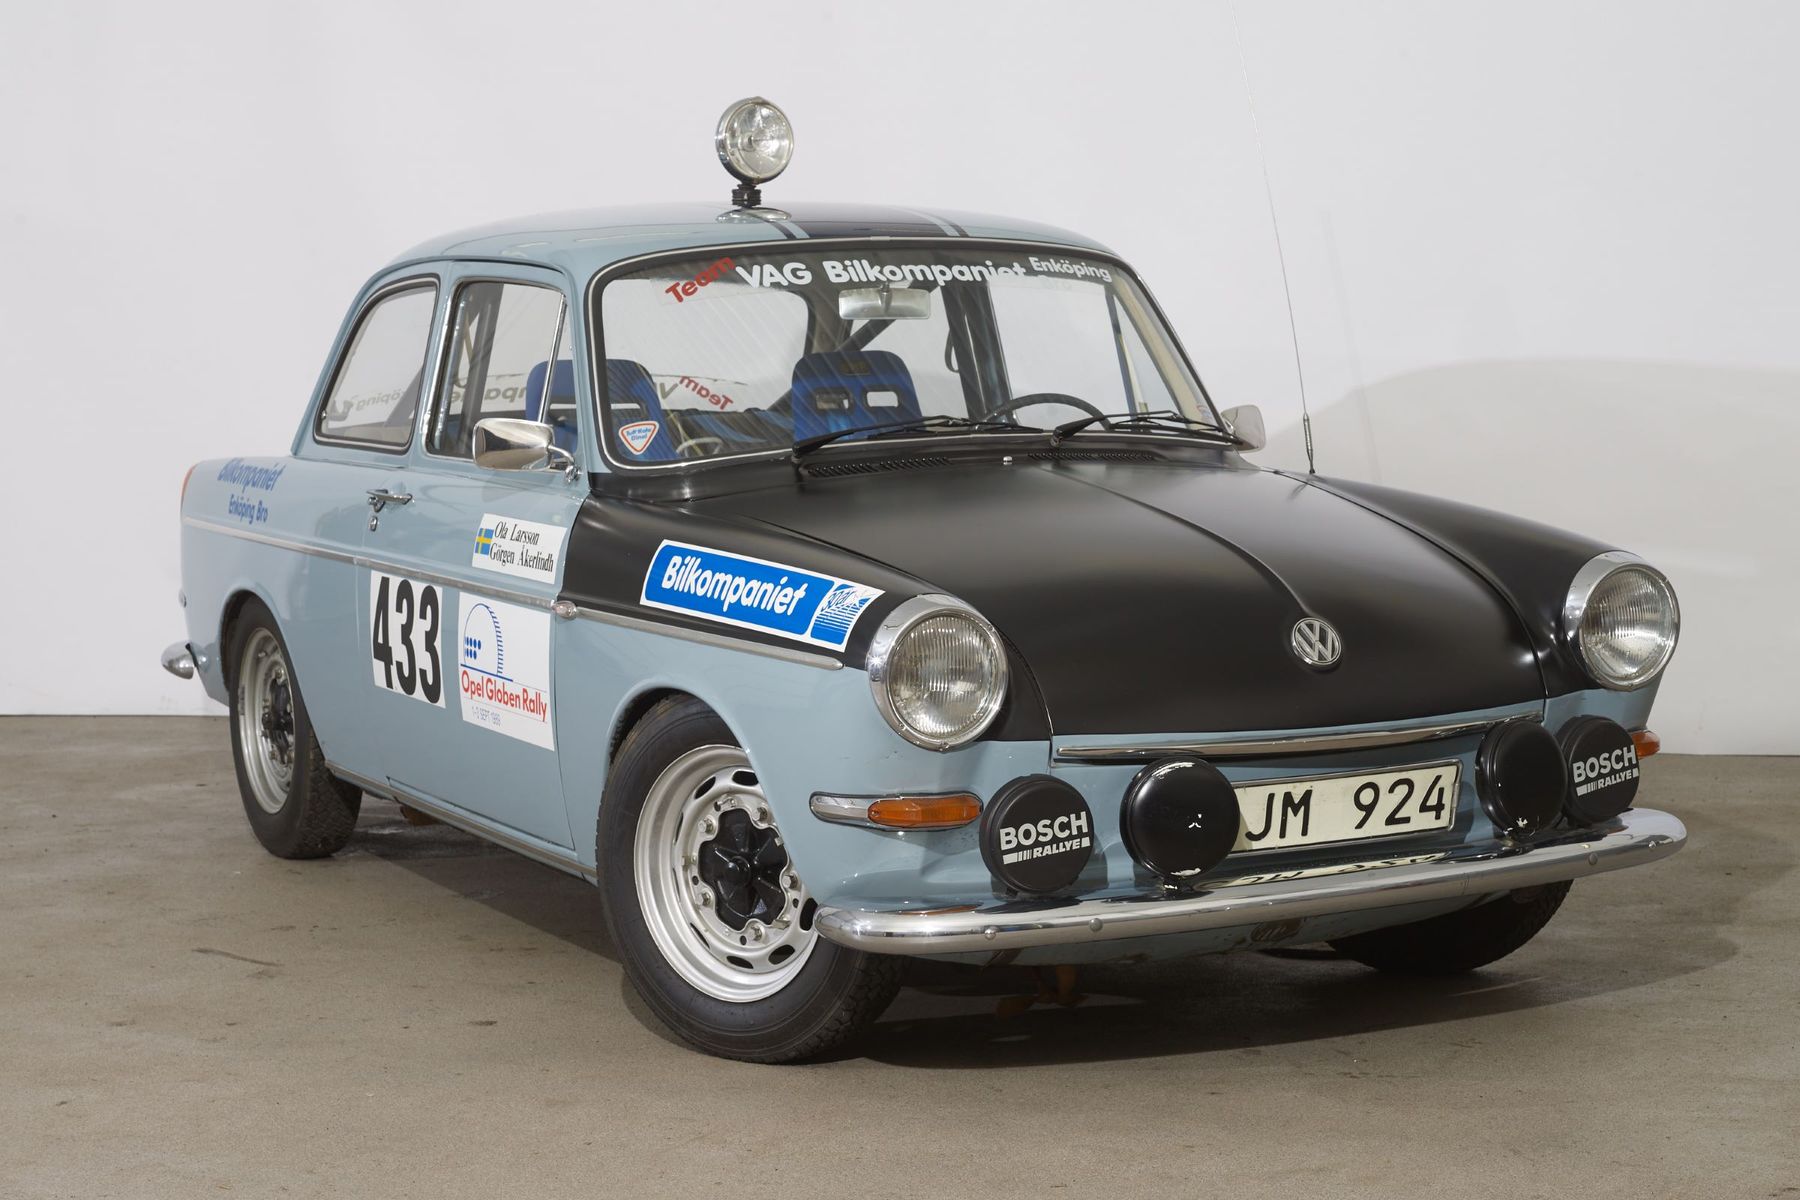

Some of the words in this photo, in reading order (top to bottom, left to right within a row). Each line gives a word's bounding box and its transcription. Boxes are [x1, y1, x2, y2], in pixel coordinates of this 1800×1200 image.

[665, 257, 736, 303] Team
[735, 262, 813, 288] VAG
[822, 259, 1026, 286] Bilkompaniet
[1028, 256, 1113, 283] Enköping
[256, 500, 268, 522] Bro
[494, 521, 508, 539] Ola
[510, 523, 540, 546] Larsson
[490, 543, 515, 567] Görgen
[517, 544, 554, 572] Åkerlindh
[661, 555, 808, 616] Bilkompaniet
[373, 576, 441, 704] 433
[461, 670, 485, 700] Opel
[485, 677, 521, 709] Globen
[522, 687, 547, 722] Rally
[1573, 744, 1637, 783] BOSCH
[1597, 769, 1632, 789] RALLYE
[1245, 789, 1313, 842] JM
[1353, 774, 1445, 830] 924
[1000, 811, 1088, 850] BOSCH
[1032, 838, 1081, 859] RALLYE
